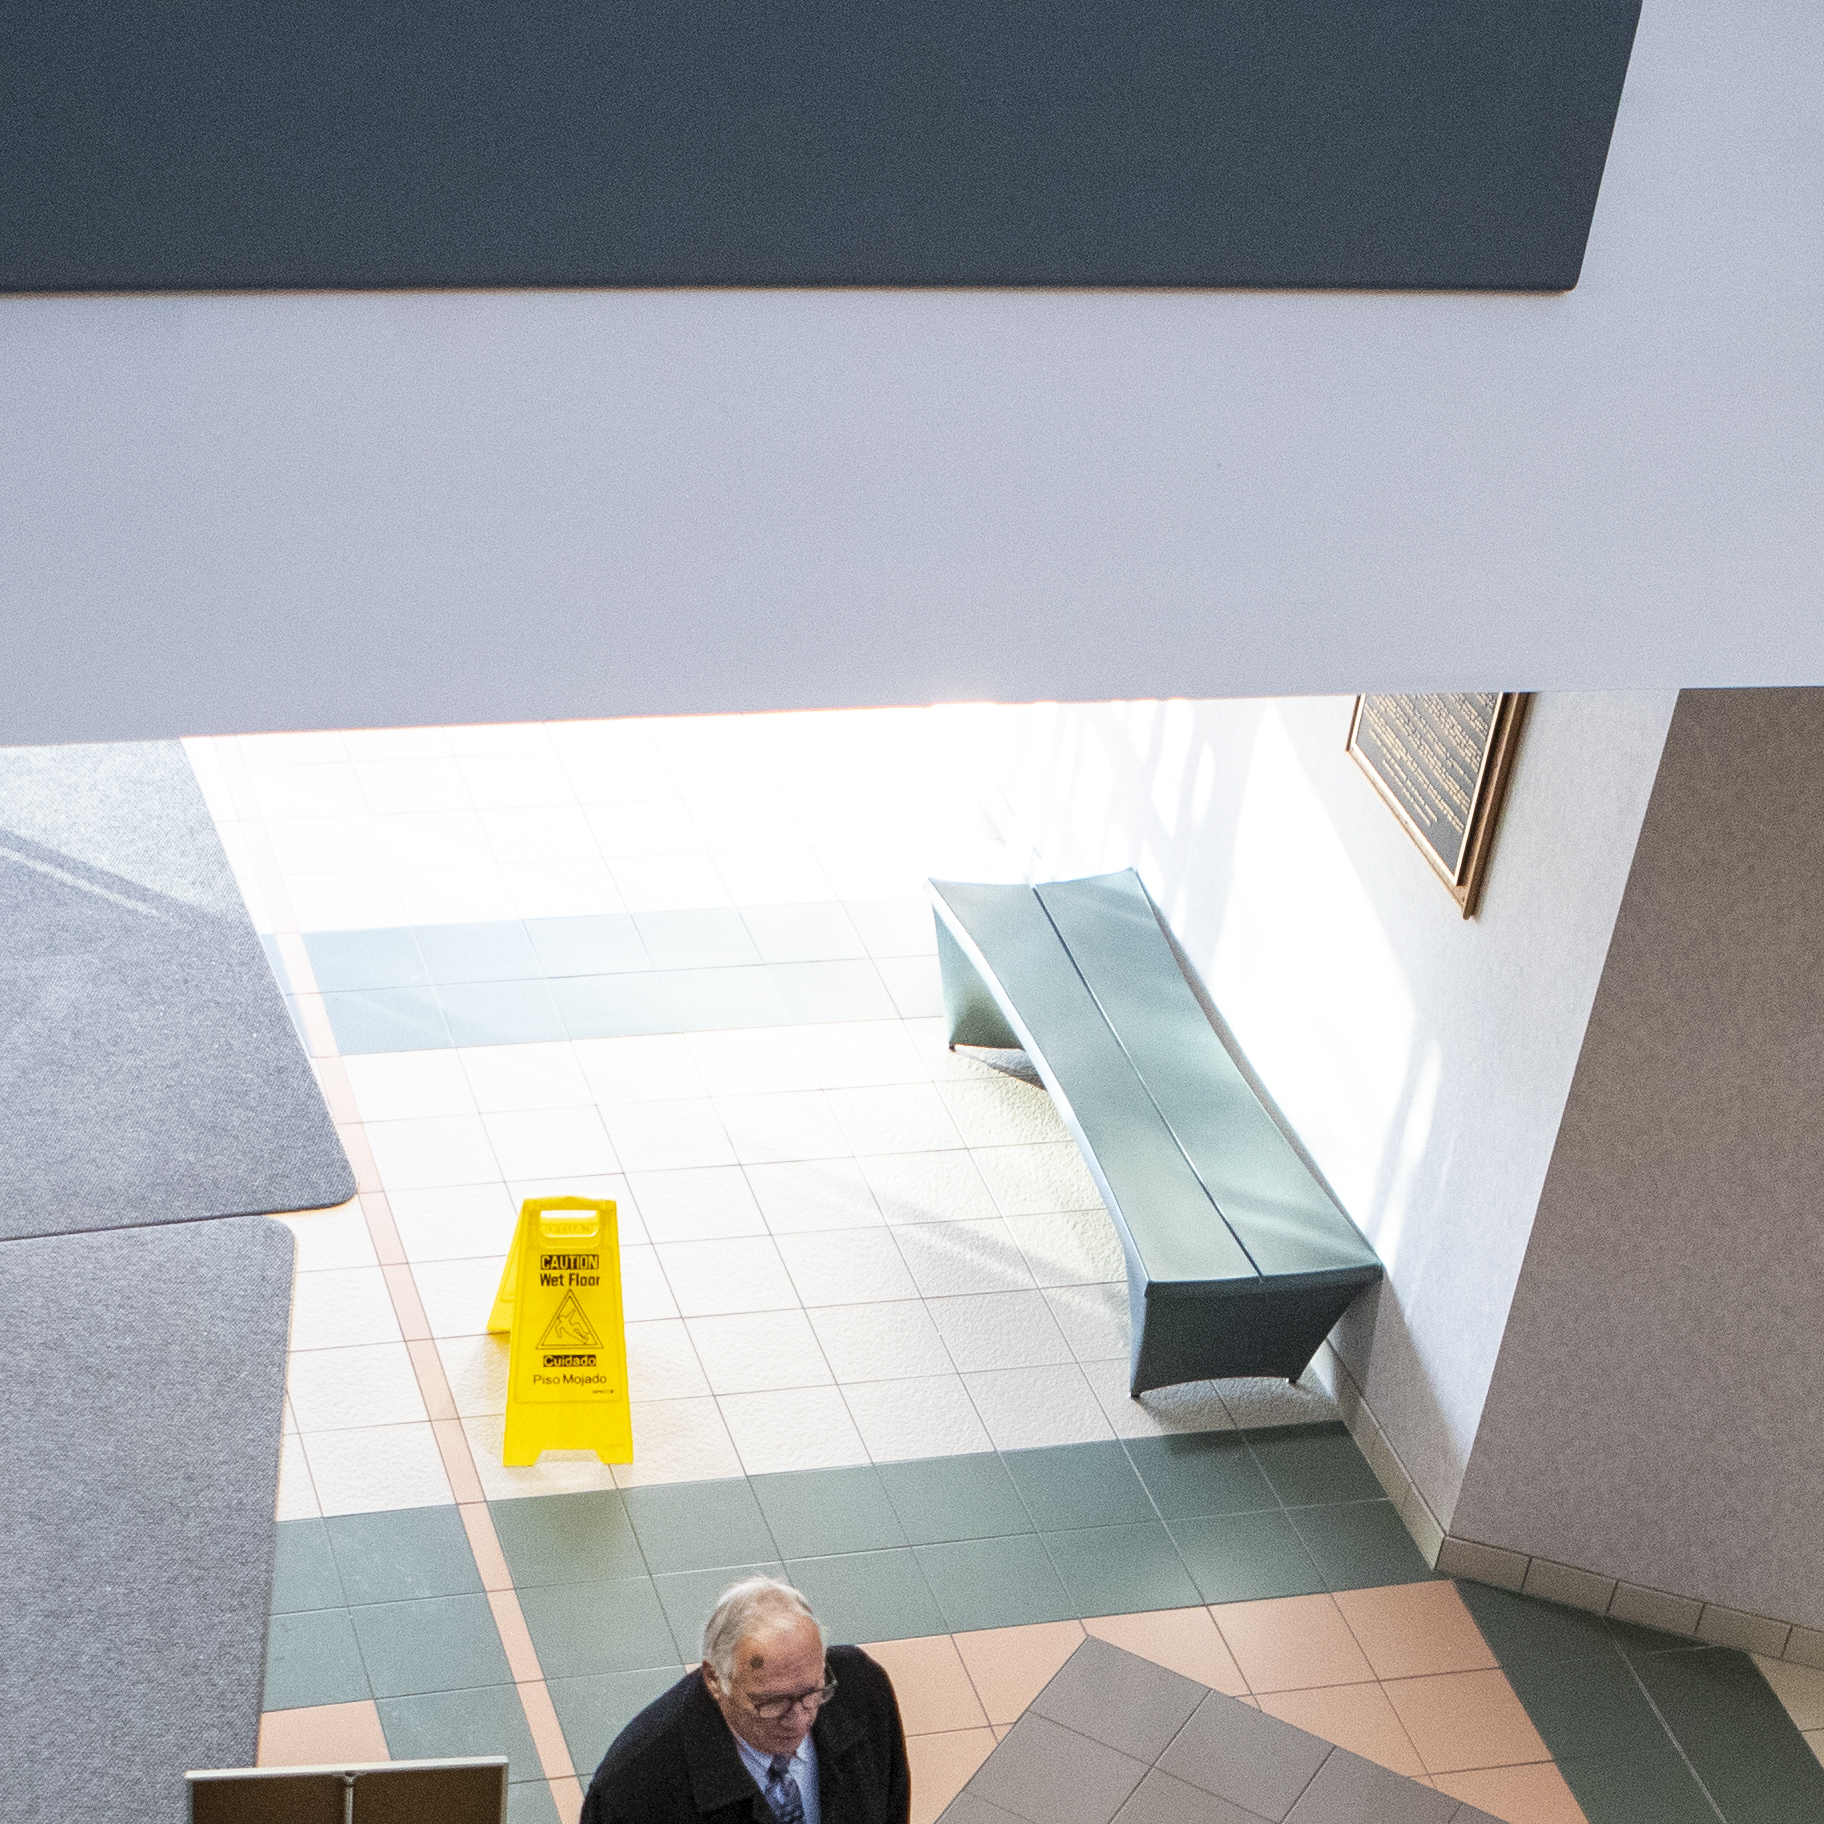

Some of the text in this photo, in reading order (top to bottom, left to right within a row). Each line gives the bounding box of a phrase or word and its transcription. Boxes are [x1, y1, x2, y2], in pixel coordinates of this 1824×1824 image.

[541, 1255, 598, 1269] CAUTION
[540, 1272, 600, 1286] Wet Floor
[544, 1355, 597, 1367] Cuidado
[533, 1374, 607, 1386] Piso Mojado
